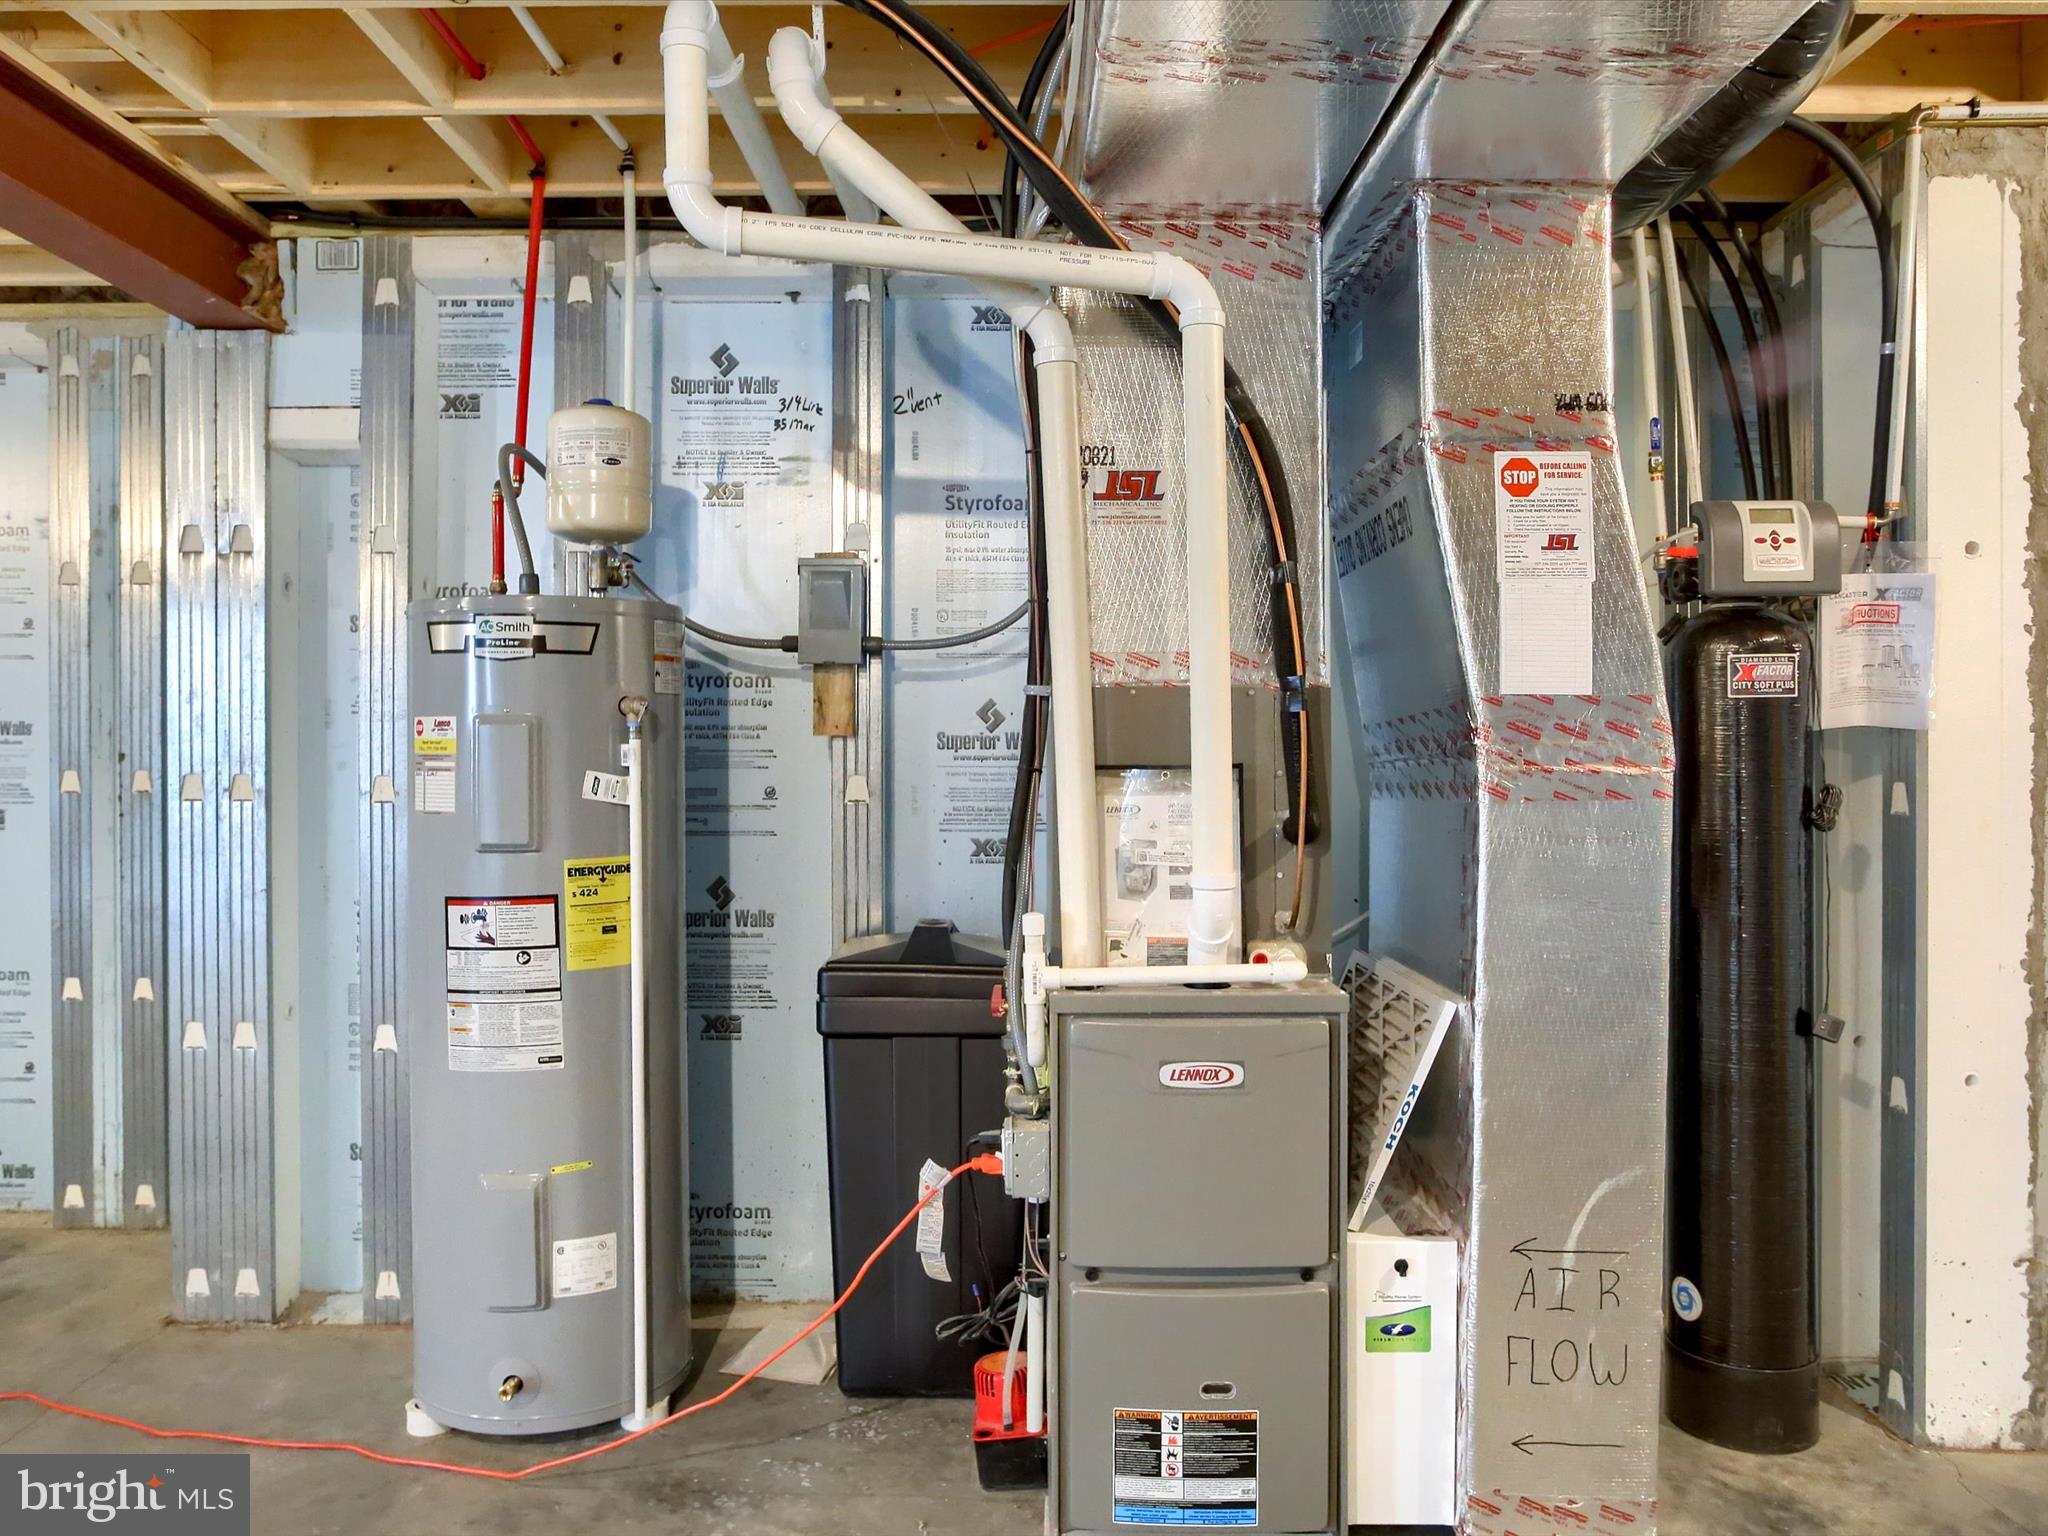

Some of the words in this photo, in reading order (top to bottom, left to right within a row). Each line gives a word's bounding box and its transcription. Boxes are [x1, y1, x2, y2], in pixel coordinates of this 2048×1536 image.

[1059, 257, 1092, 265] PRESSURE
[671, 375, 734, 396] Superior
[737, 375, 779, 395] Walls
[686, 397, 767, 406] www.superiorwalls.com
[910, 391, 943, 414] vent
[1503, 470, 1536, 484] STOP
[945, 494, 1028, 514] Styrofoa
[945, 520, 984, 530] UtilityFit
[986, 520, 1019, 529] Routed
[945, 530, 990, 539] Insulation
[496, 622, 530, 632] Smith
[684, 673, 773, 694] tyrofoam
[1733, 681, 1752, 689] CITY
[1754, 681, 1775, 689] SOFT
[1776, 681, 1794, 689] PLUS
[717, 698, 749, 707] Routed
[751, 698, 773, 709] Edge
[684, 709, 720, 717] sulation
[936, 731, 1000, 752] Superior
[952, 754, 1019, 762] www.superiorwalls
[568, 863, 631, 879] ENERGYGUIDE
[579, 888, 599, 897] 424
[687, 909, 731, 929] perior
[735, 909, 775, 928] Walls
[1170, 1068, 1222, 1081] LENNOX
[1385, 1083, 1419, 1150] KOCH
[2, 1164, 35, 1180] Walls
[689, 1203, 772, 1223] tyrofoam
[717, 1228, 749, 1237] Routed
[751, 1228, 773, 1238] Edge
[1514, 1267, 1620, 1312] AIR
[1508, 1336, 1628, 1386] FLOW
